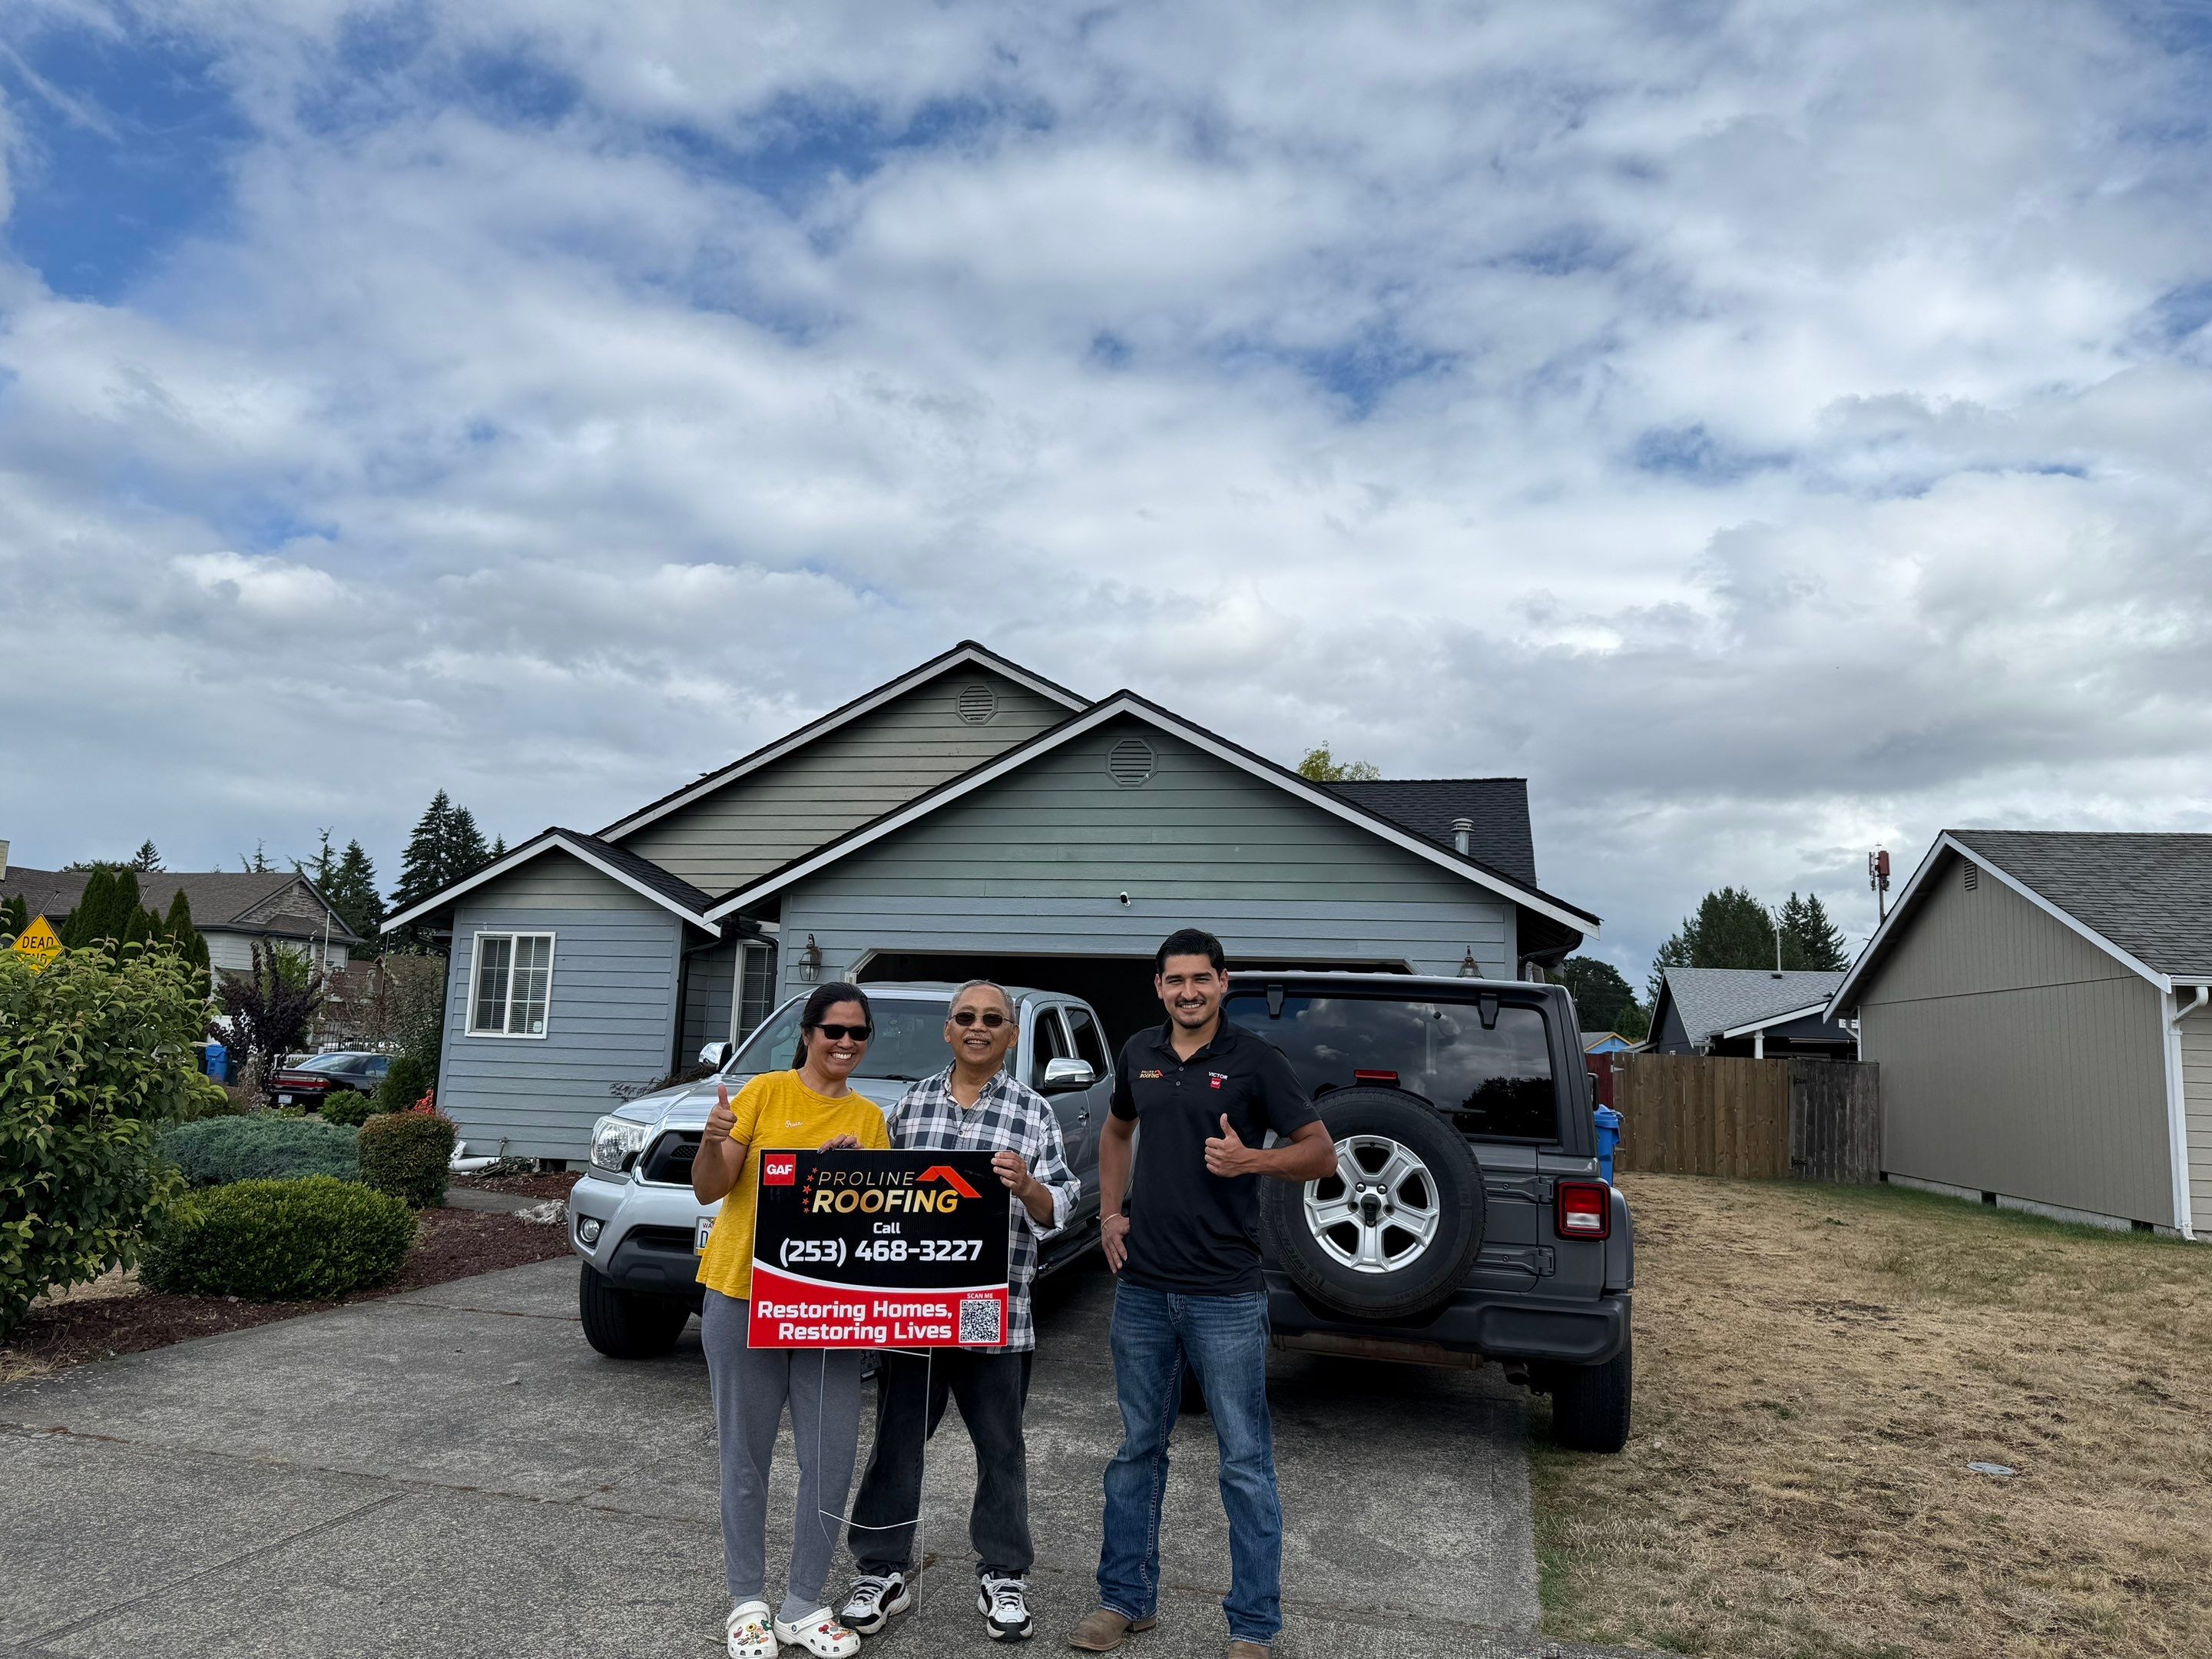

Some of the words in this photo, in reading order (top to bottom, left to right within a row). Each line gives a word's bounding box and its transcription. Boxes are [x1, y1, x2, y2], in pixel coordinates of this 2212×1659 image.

[22, 936, 54, 949] DEAD
[1208, 1071, 1228, 1080] VICTOR
[767, 1164, 793, 1175] GAF
[818, 1171, 915, 1186] PROLINE
[812, 1189, 959, 1214] ROOFING
[873, 1222, 901, 1234] Call
[780, 1237, 846, 1267] (253)
[854, 1240, 983, 1261] 468-3227
[757, 1300, 866, 1320] Restoring
[873, 1300, 953, 1320] Homes,
[778, 1322, 887, 1343] Restoring
[894, 1322, 952, 1339] Lives
